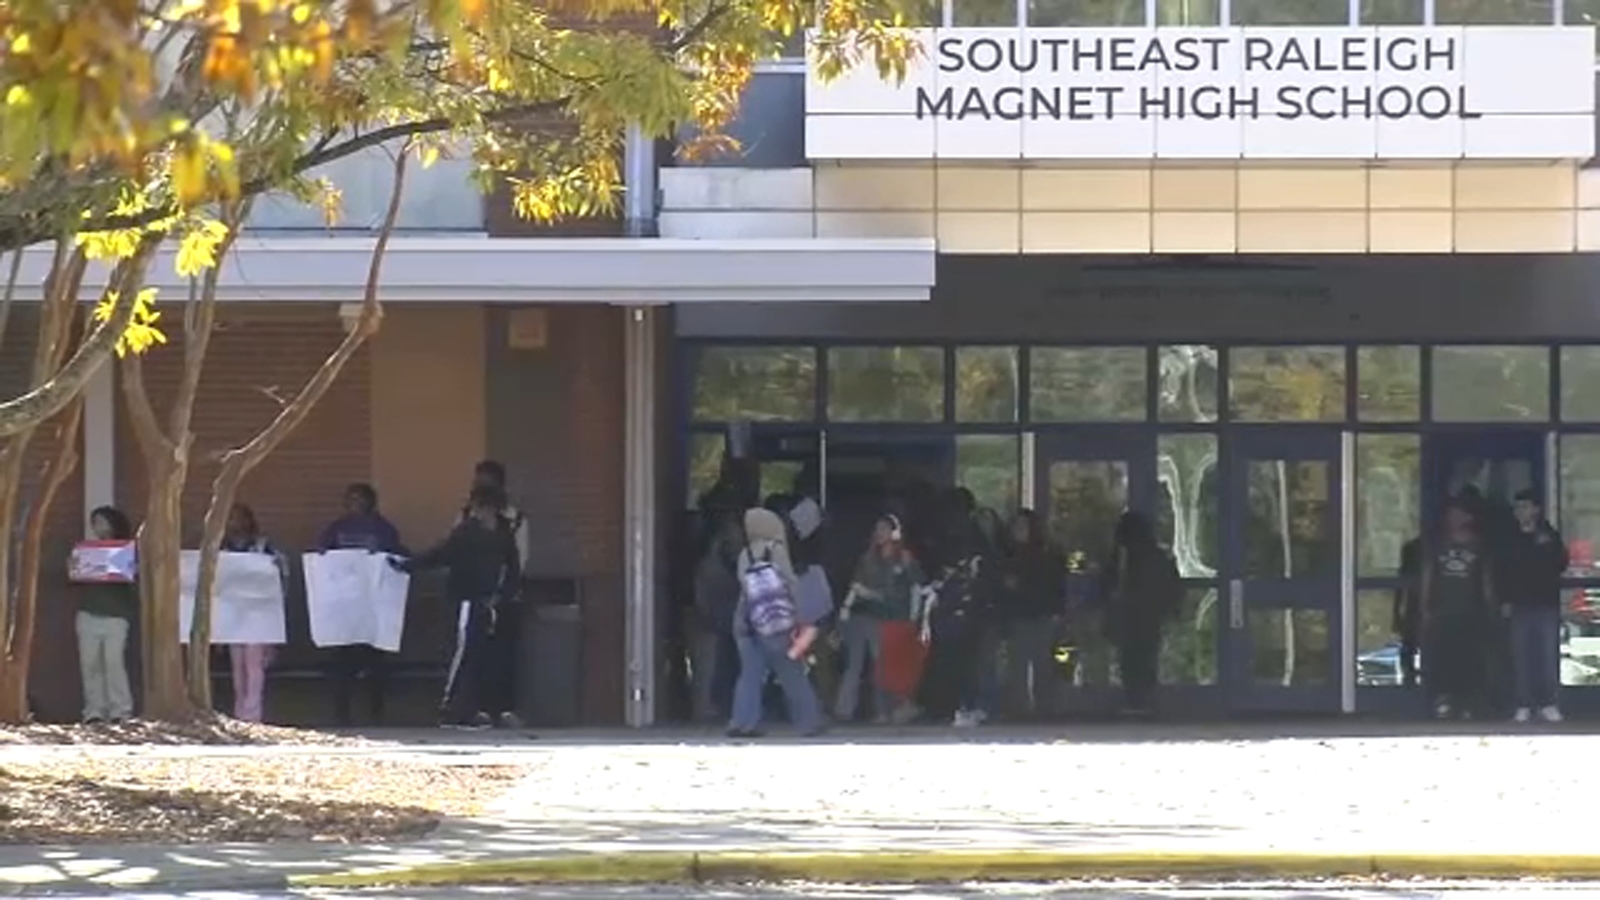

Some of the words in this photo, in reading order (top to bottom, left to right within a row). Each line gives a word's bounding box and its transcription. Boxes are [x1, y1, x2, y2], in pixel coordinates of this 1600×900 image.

[939, 38, 1229, 72] SOUTHEAST
[1246, 38, 1454, 72] RALEIGH
[916, 86, 1123, 120] MAGNET
[1140, 86, 1258, 120] HIGH
[1276, 86, 1482, 120] SCHOOL
